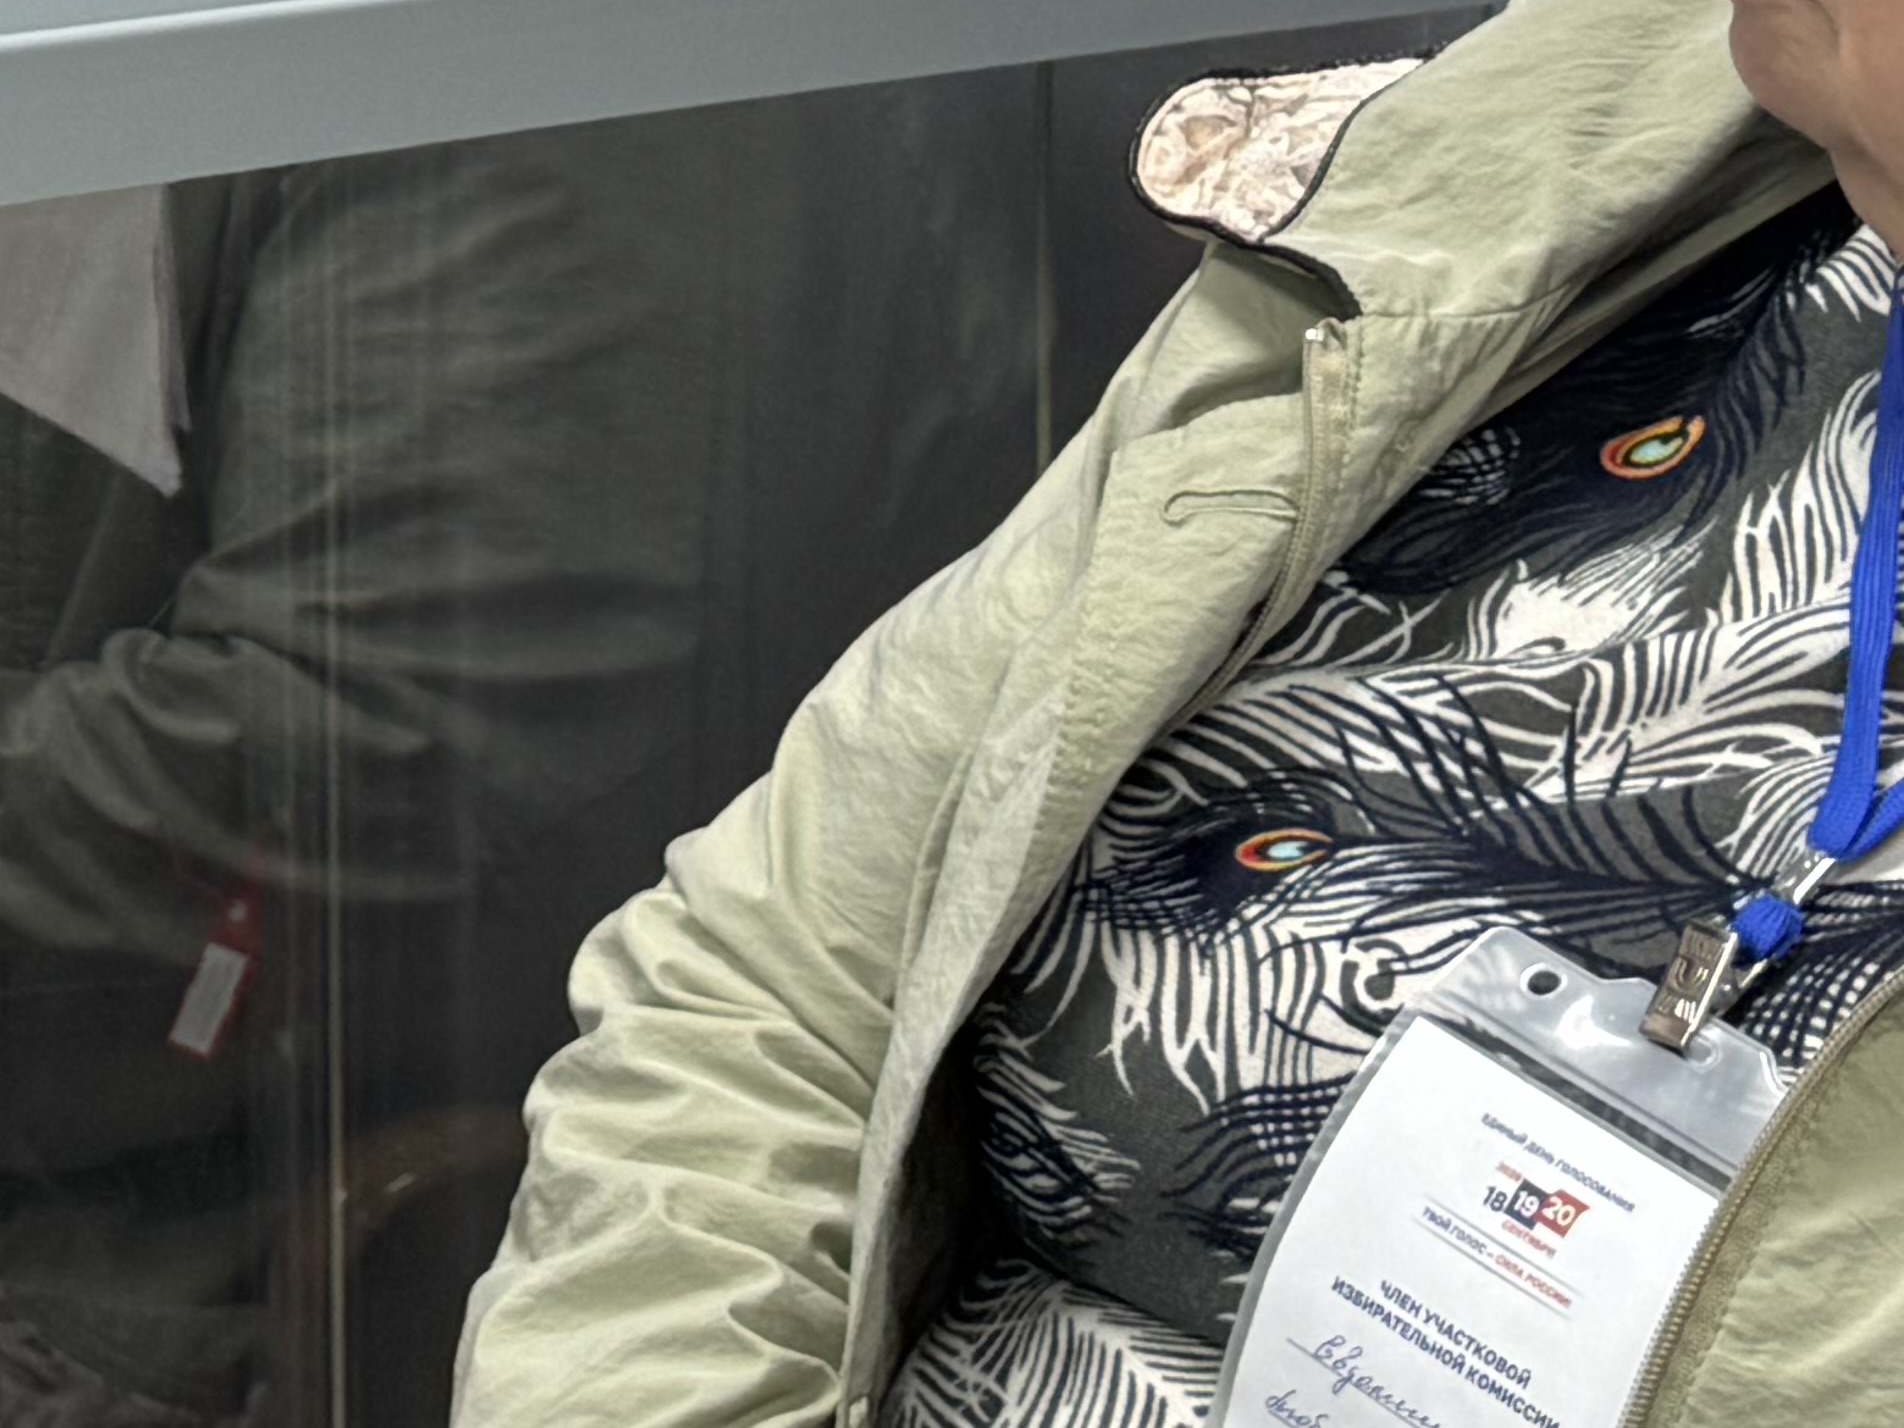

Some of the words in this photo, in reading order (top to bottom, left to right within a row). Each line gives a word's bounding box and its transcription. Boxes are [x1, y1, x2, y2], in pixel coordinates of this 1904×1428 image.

[1483, 1185, 1508, 1213] 18
[1555, 1158, 1636, 1213] ГОЛОСОВАНИЯ
[1513, 1190, 1539, 1218] 19
[1542, 1195, 1576, 1226] 20
[1449, 1224, 1488, 1255] ГОЛОС
[1331, 1275, 1467, 1377] ИЗБИРАТЕЛЬНОЙ
[1380, 1279, 1423, 1319] ЧЛЕН
[1423, 1308, 1532, 1391] УЧАСТКОВОЙ
